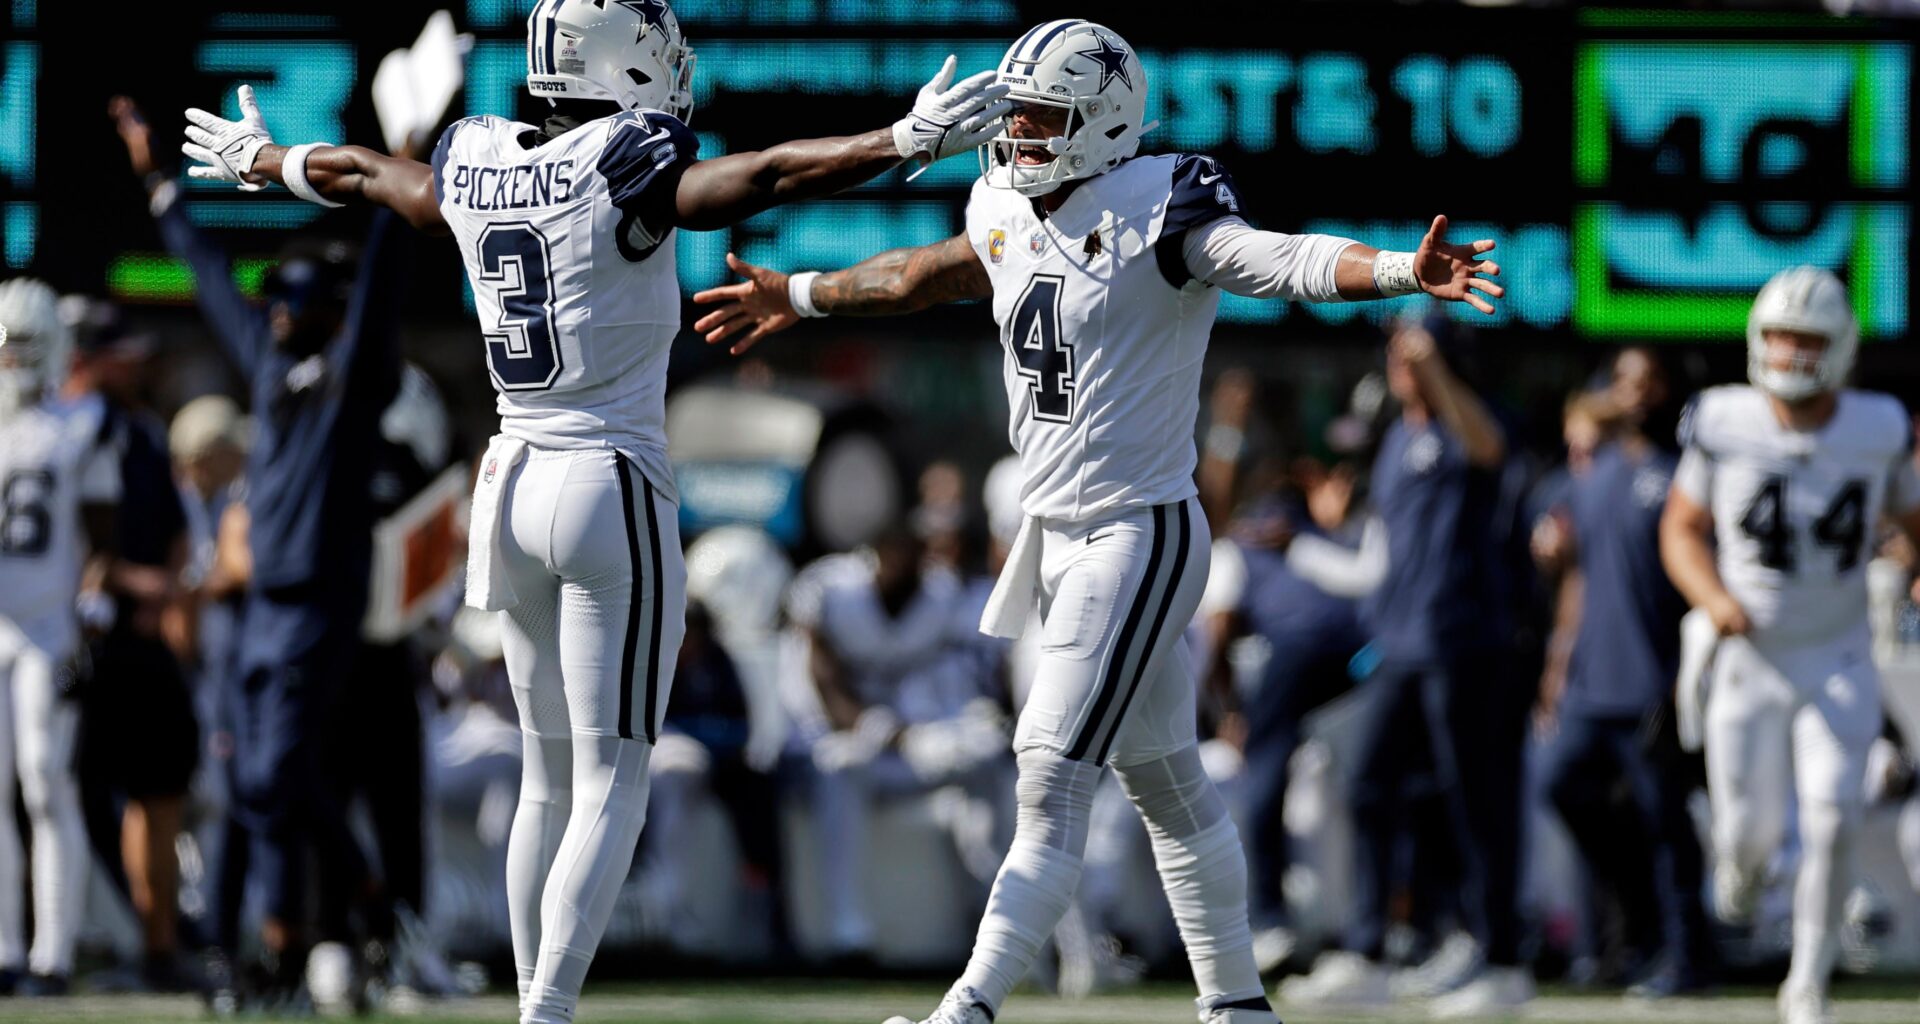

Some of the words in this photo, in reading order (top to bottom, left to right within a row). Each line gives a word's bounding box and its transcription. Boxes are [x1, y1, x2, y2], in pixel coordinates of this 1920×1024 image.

[1390, 52, 1524, 158] 10
[453, 160, 575, 211] PICKENS
[1215, 182, 1240, 212] 4
[476, 220, 564, 392] 3
[1007, 273, 1075, 425] 4
[1739, 473, 1873, 574] 44
